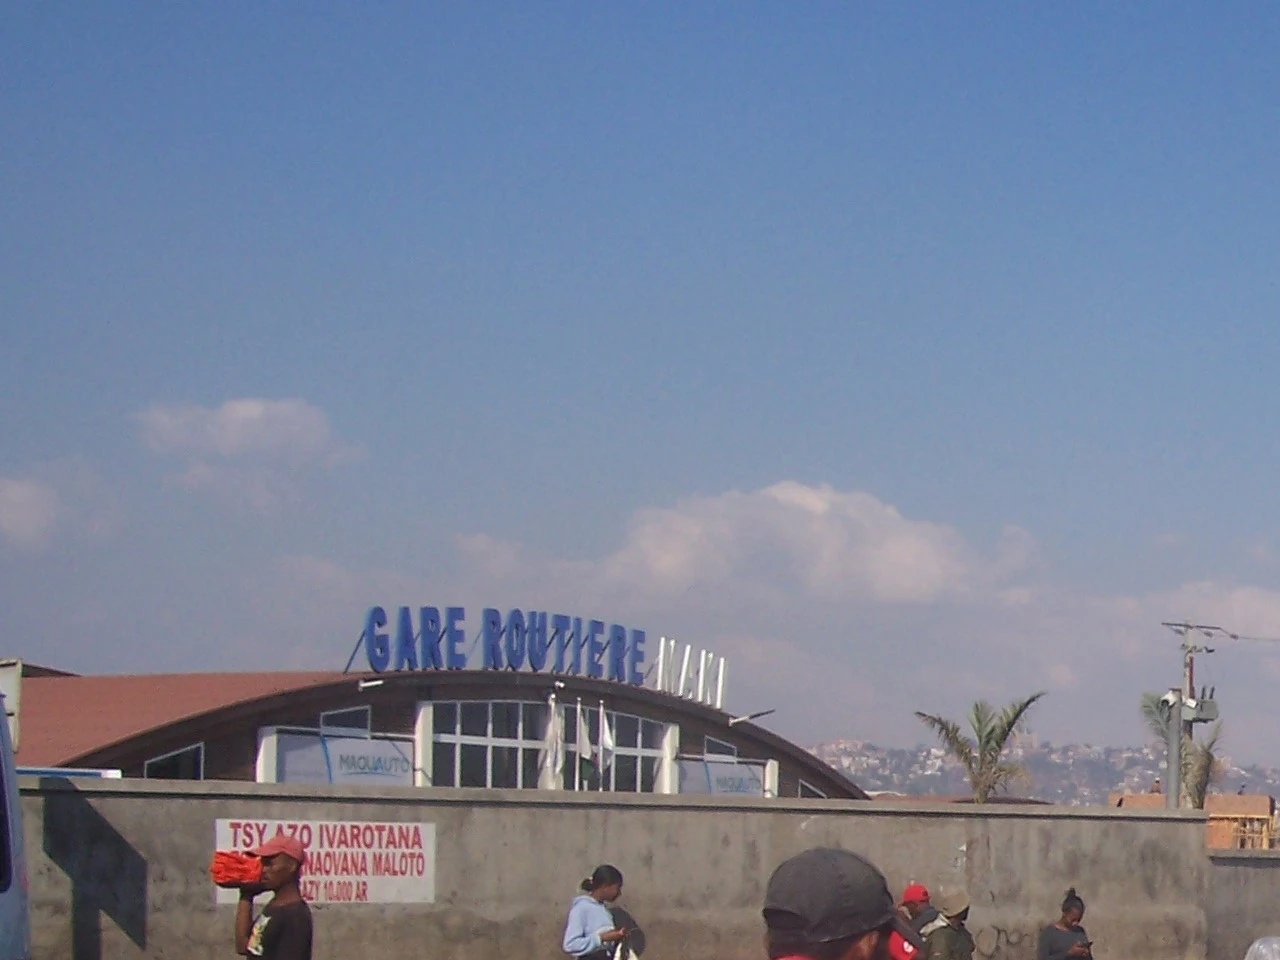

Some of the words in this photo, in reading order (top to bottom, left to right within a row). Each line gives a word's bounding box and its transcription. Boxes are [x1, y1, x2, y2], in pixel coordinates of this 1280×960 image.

[366, 606, 466, 672] GARE
[482, 608, 646, 687] ROUTIERE
[229, 822, 267, 848] TSY
[319, 824, 423, 849] IVAROTANA
[302, 851, 368, 876] NAOVANA
[372, 852, 425, 876] MALOTO
[301, 880, 320, 901] AZY
